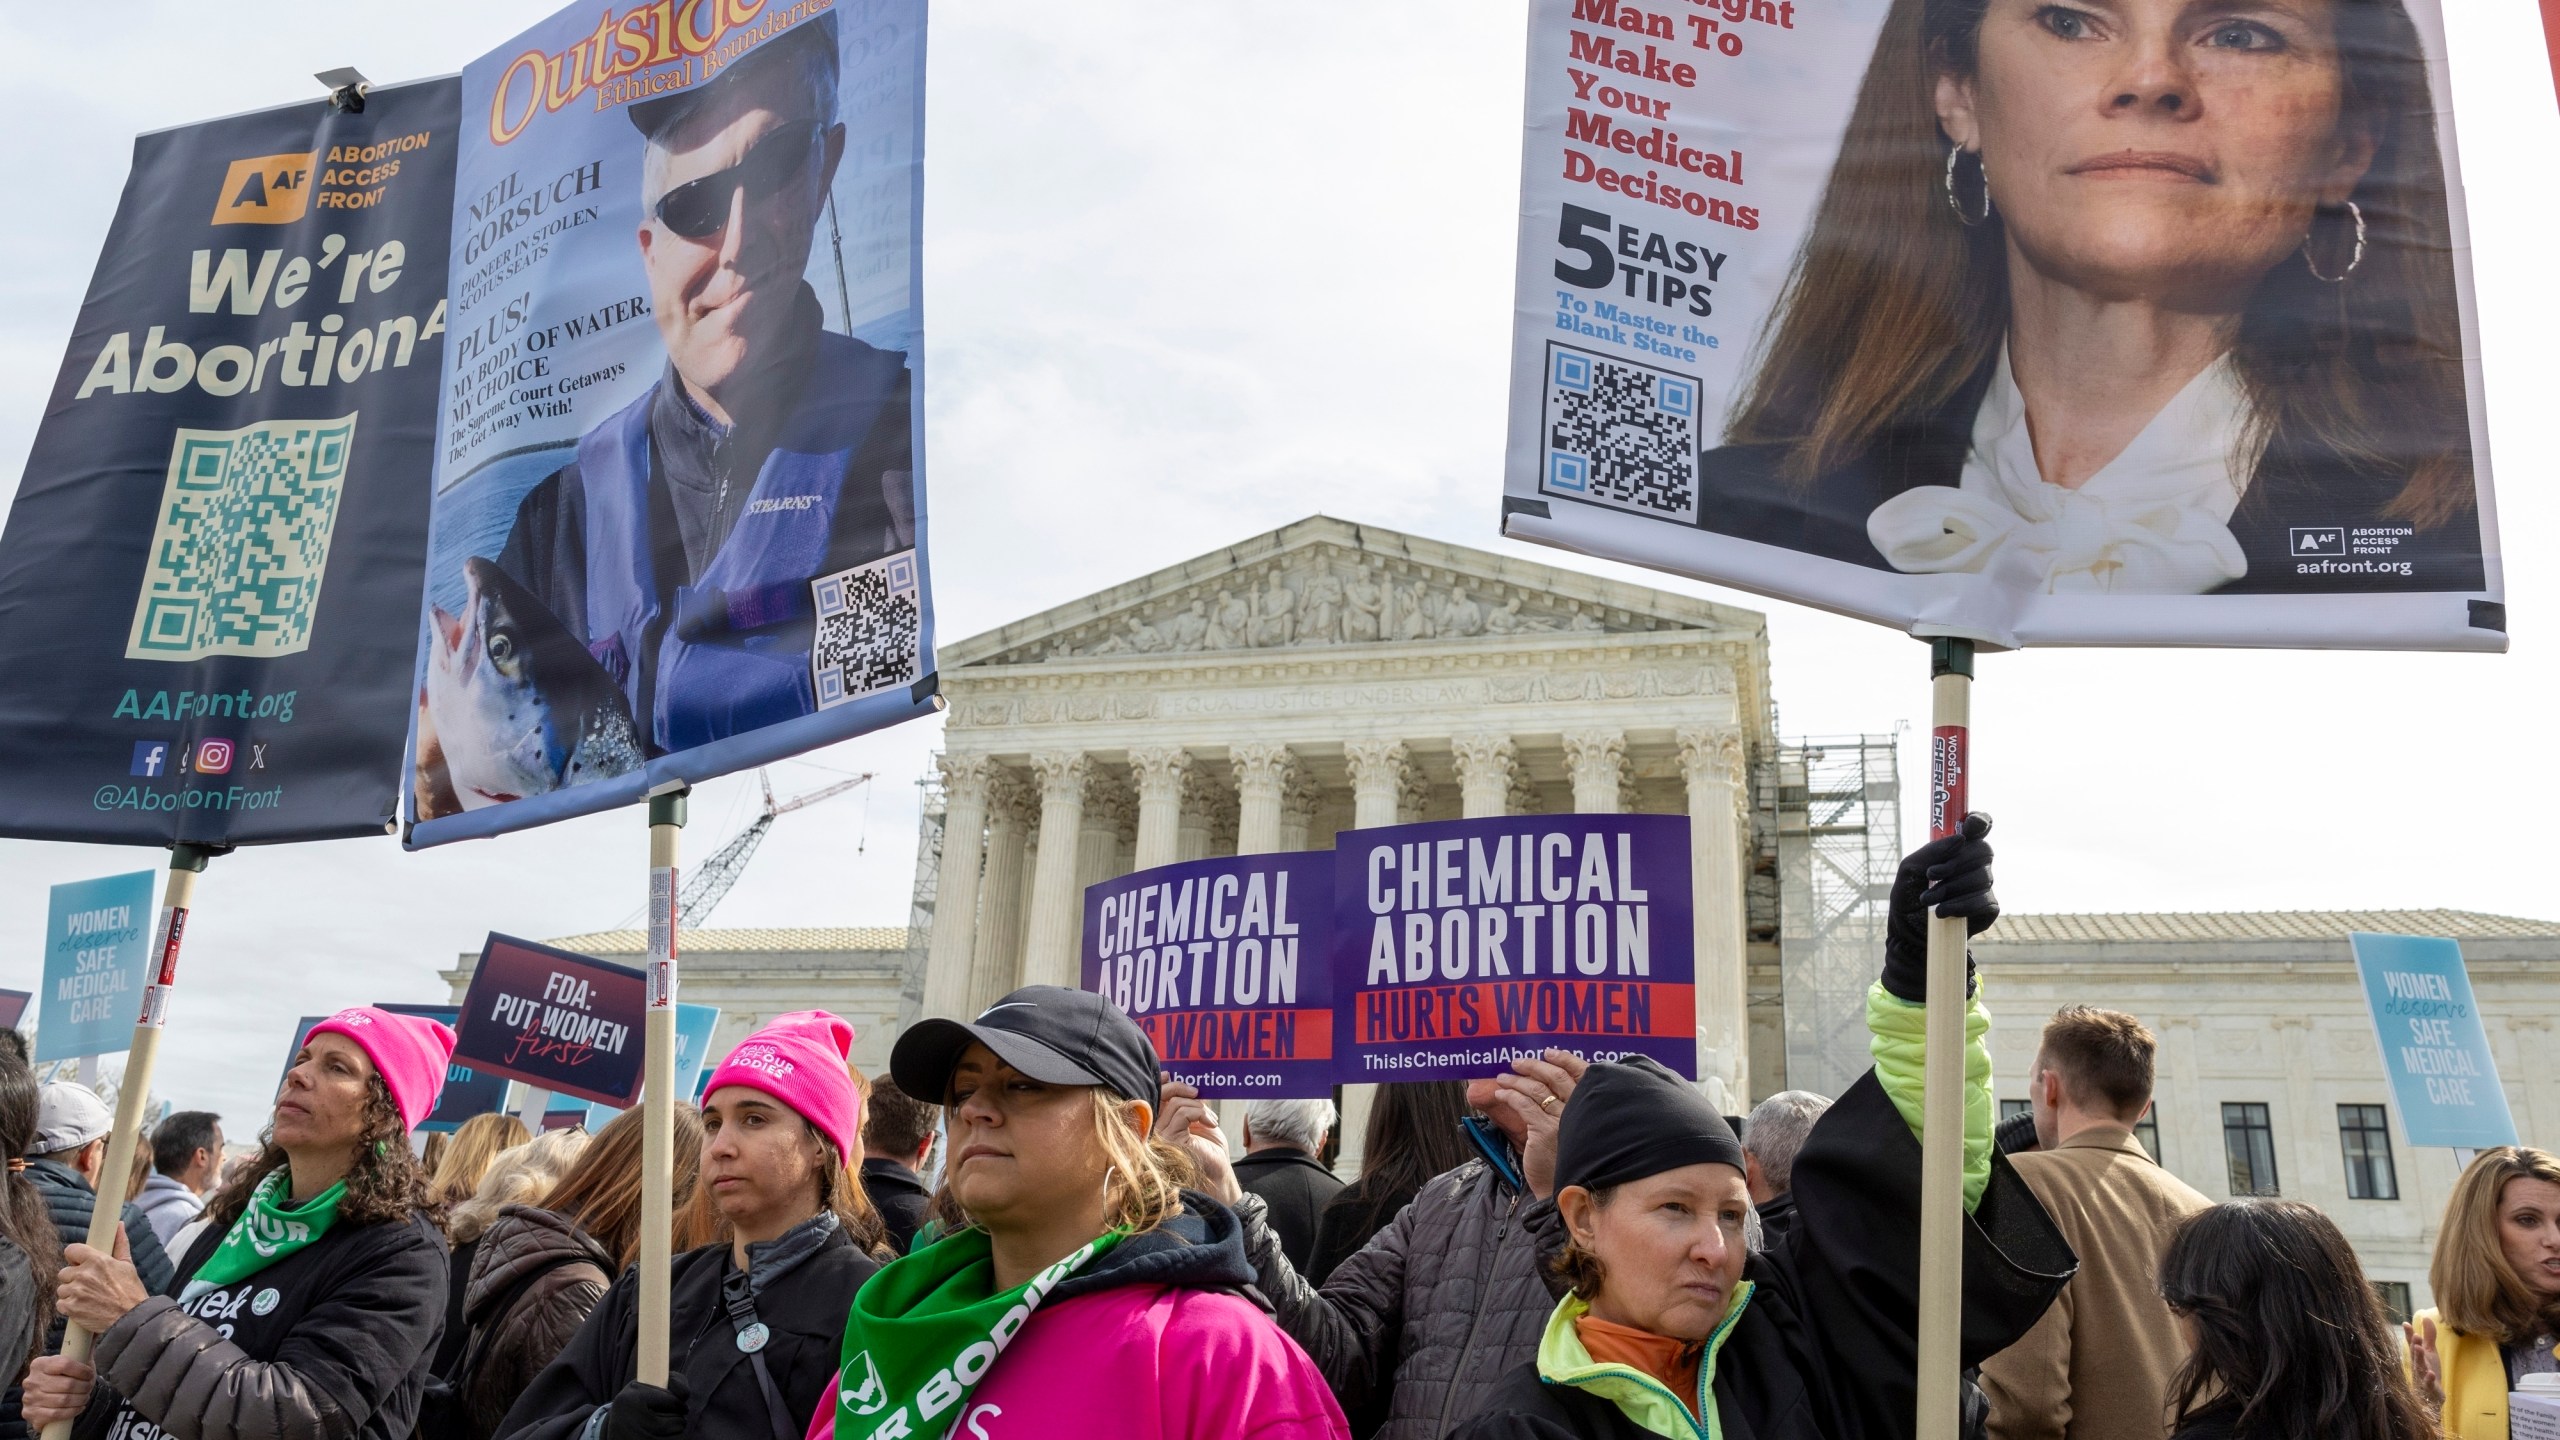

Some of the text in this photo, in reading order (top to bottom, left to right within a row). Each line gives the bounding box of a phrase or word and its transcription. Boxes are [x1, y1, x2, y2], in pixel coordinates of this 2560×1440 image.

[1571, 0, 1743, 57] Man To
[1569, 29, 1697, 88] Make
[593, 58, 691, 112] Ethical
[1567, 67, 1671, 121] Your
[326, 132, 430, 163] ABORTION
[1565, 107, 1743, 185] Medical
[316, 186, 386, 209] FRONT
[321, 159, 400, 187] ACCESS
[1563, 148, 1759, 230] Decisons
[465, 160, 604, 265] GORSUCH
[467, 170, 525, 233] NEIL
[461, 206, 599, 298] PIONEER IN STOLEN
[1554, 202, 1727, 289] 5 EASY
[459, 242, 549, 315] SCOTUS SEATS
[1619, 262, 1712, 317] TIPS
[456, 292, 530, 372] PLUS!
[1556, 290, 1719, 349] To Master the
[1556, 311, 1696, 363] Blank Stare
[452, 296, 651, 403] MY BODY OF WATER,
[450, 361, 626, 446] The Supreme Court Getaways
[451, 356, 550, 428] MY CHOICE
[449, 398, 572, 464] They Get Away With!
[2352, 528, 2412, 536] ABORTION
[2353, 537, 2399, 545] ACCESS
[2297, 560, 2412, 575] aafront.org
[1250, 690, 1333, 711] JUSTICE
[1344, 687, 1416, 706] UNDER
[1425, 684, 1469, 703] LAW
[1948, 735, 1957, 786] WOOSTER
[94, 783, 282, 811] @AborionFront
[1368, 832, 1648, 914] CHEMICAL
[58, 927, 138, 953] deserve
[68, 905, 130, 936] WOMEN
[1098, 870, 1299, 959] CHEMICAL
[75, 945, 117, 974] SAFE
[1366, 904, 1650, 985] ABORTION
[58, 969, 129, 1001] MEDICAL
[543, 971, 597, 1011] FDA:
[1098, 937, 1299, 1015] ABORTION
[2383, 971, 2452, 1001] WOMEN
[70, 996, 112, 1023] CARE
[490, 992, 541, 1029] PUT
[540, 1005, 629, 1055] WOMEN
[1367, 982, 1650, 1042] HURTS WOMEN
[2385, 988, 2467, 1018] deserve
[504, 1017, 593, 1065] first
[1165, 1011, 1296, 1059] WOMEN
[2409, 1018, 2456, 1046] SAFE
[729, 1058, 785, 1078] BODIES
[763, 1053, 795, 1074] OUR
[1169, 1072, 1282, 1086] bortion.com
[2401, 1046, 2481, 1076] MEDICAL
[2425, 1077, 2475, 1106] CARE
